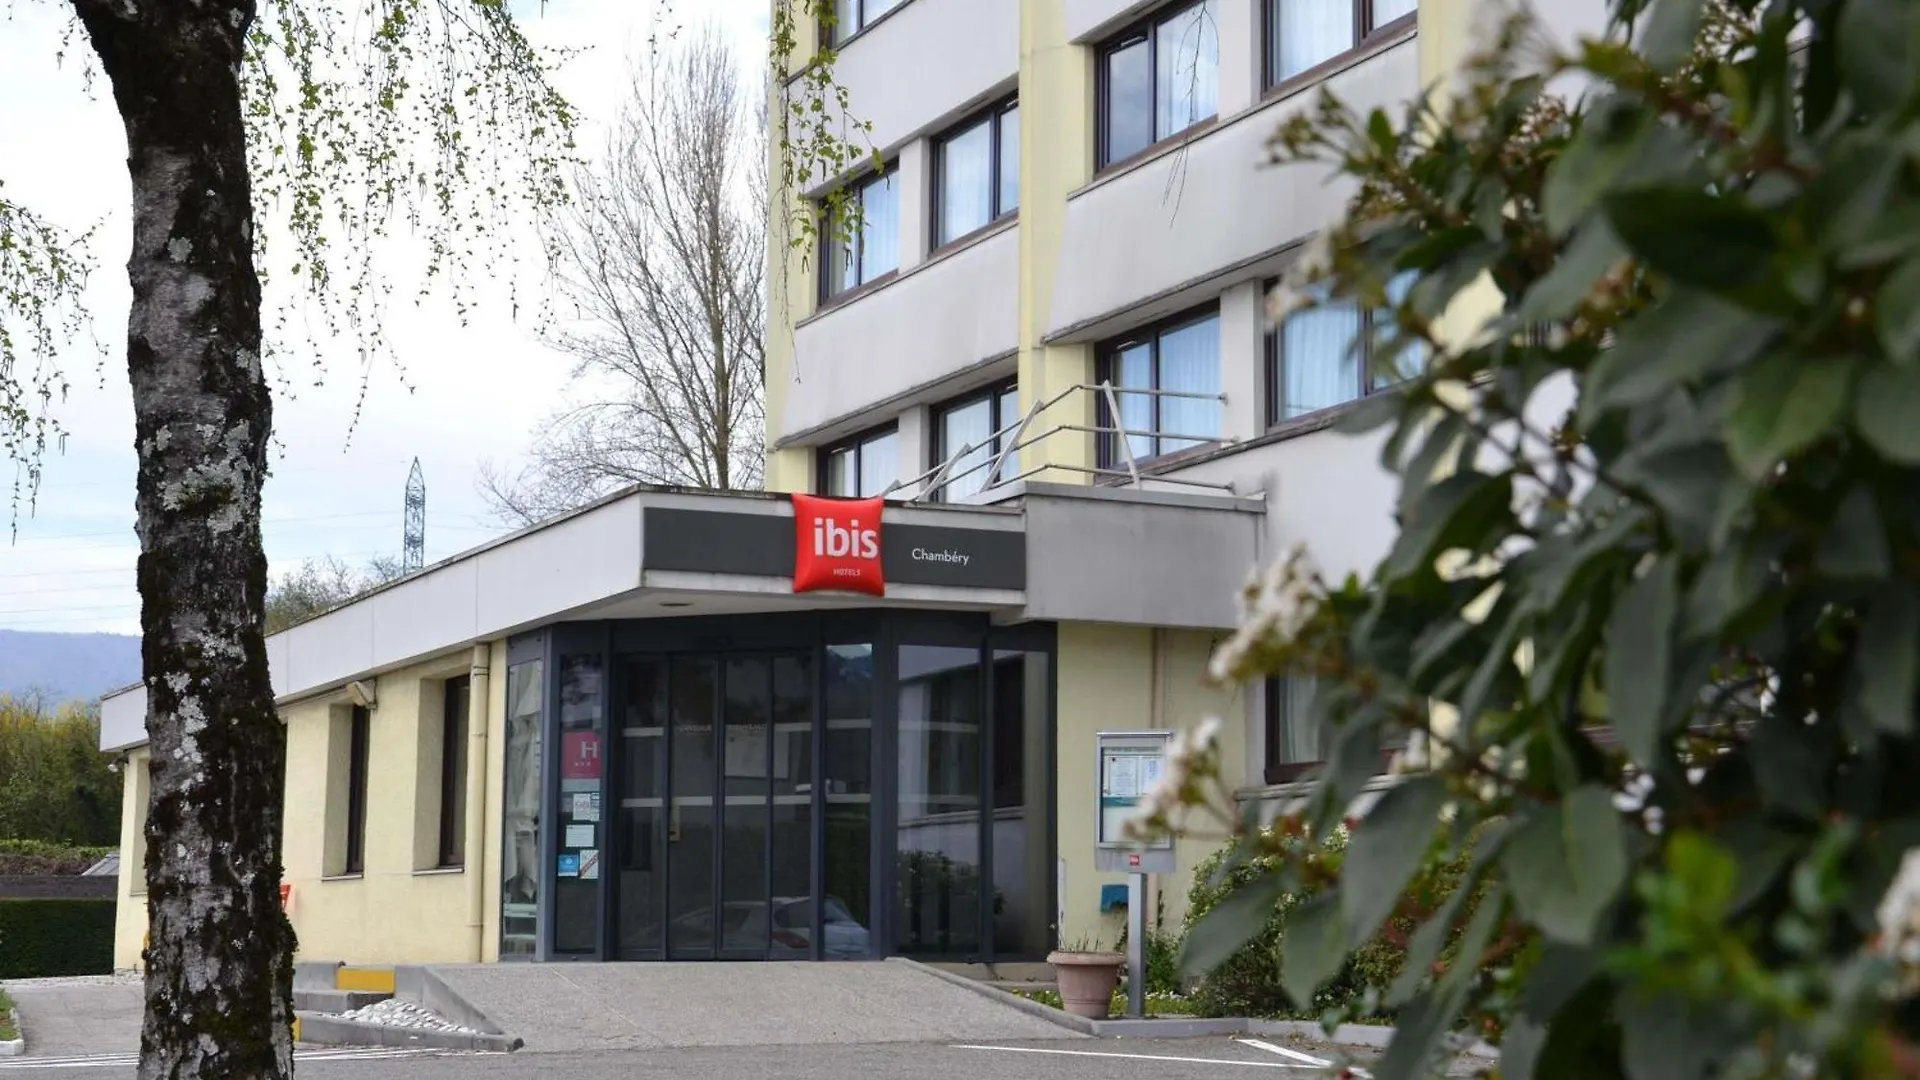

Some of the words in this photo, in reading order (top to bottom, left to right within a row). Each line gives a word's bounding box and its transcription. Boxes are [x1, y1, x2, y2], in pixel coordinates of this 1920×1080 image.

[814, 518, 878, 558] ibis
[912, 548, 969, 565] Chambéry
[833, 568, 861, 577] HOTELS
[581, 741, 598, 758] H
